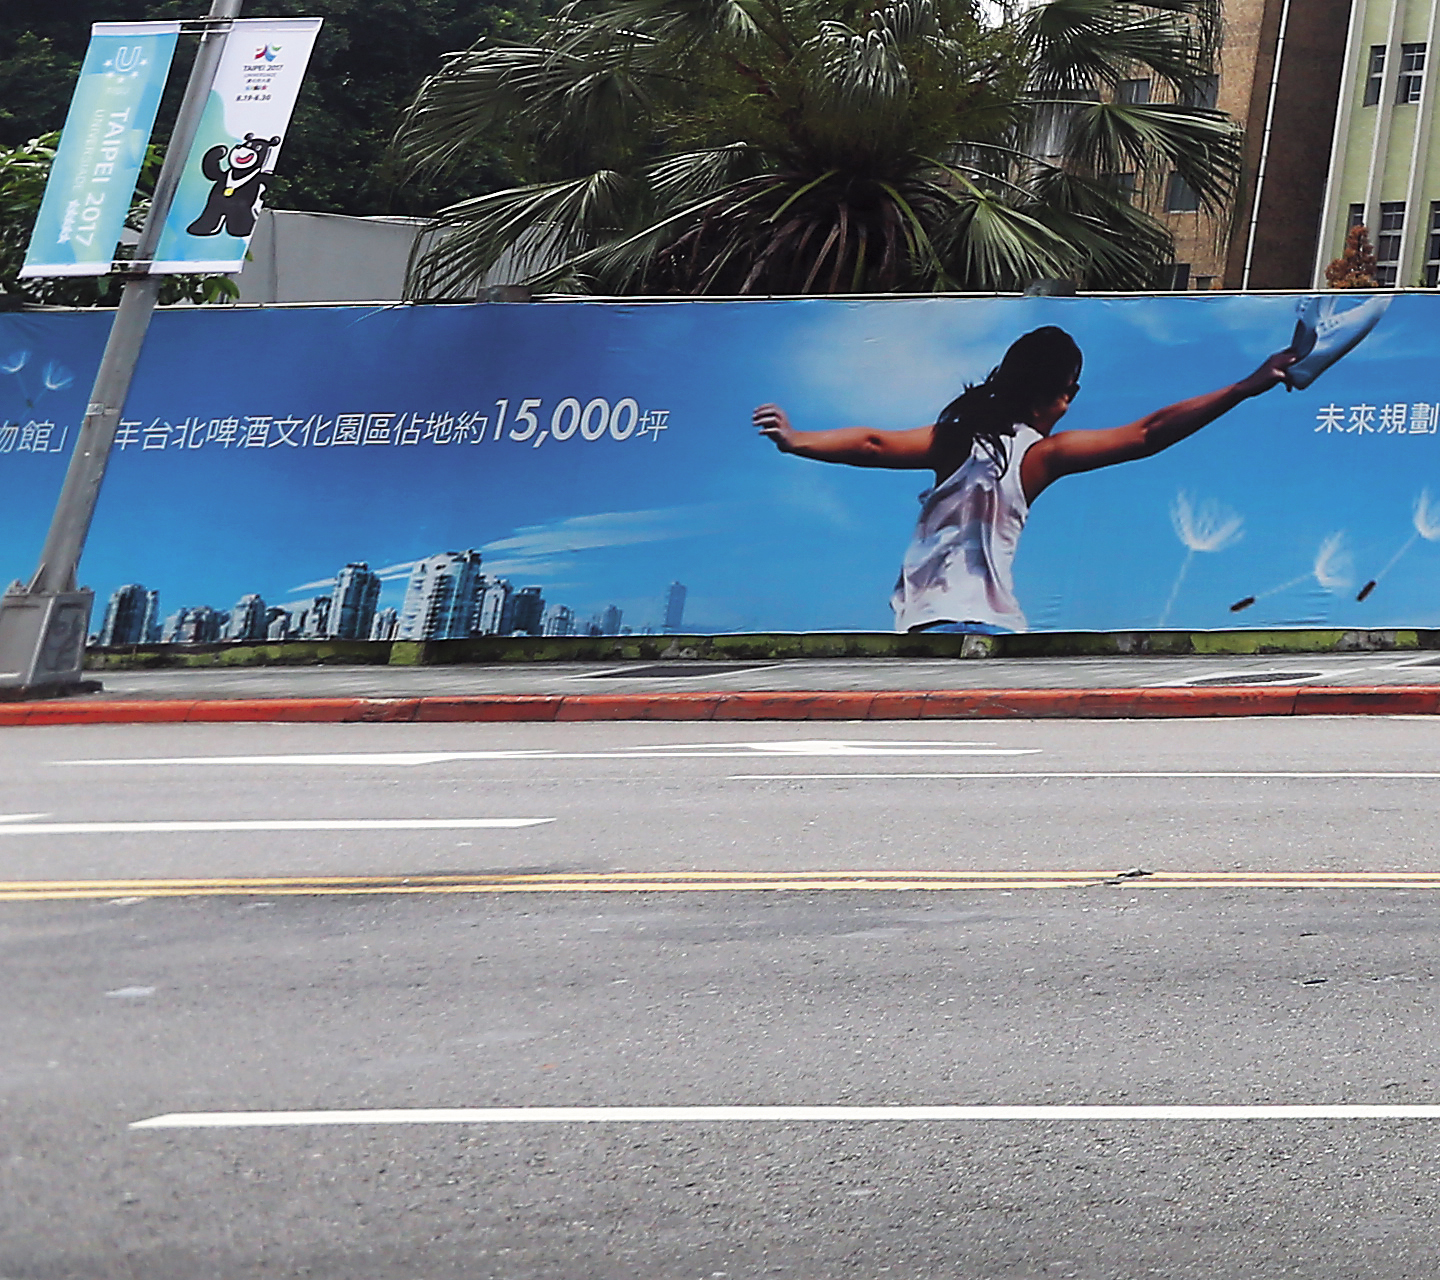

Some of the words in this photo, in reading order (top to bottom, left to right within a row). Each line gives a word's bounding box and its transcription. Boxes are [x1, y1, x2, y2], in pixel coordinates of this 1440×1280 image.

[243, 64, 265, 72] TAIPEI
[92, 107, 131, 183] TAIPEI
[76, 192, 105, 247] 2017
[112, 397, 670, 451] 年台北啤酒文化園區佔地約15,000坪
